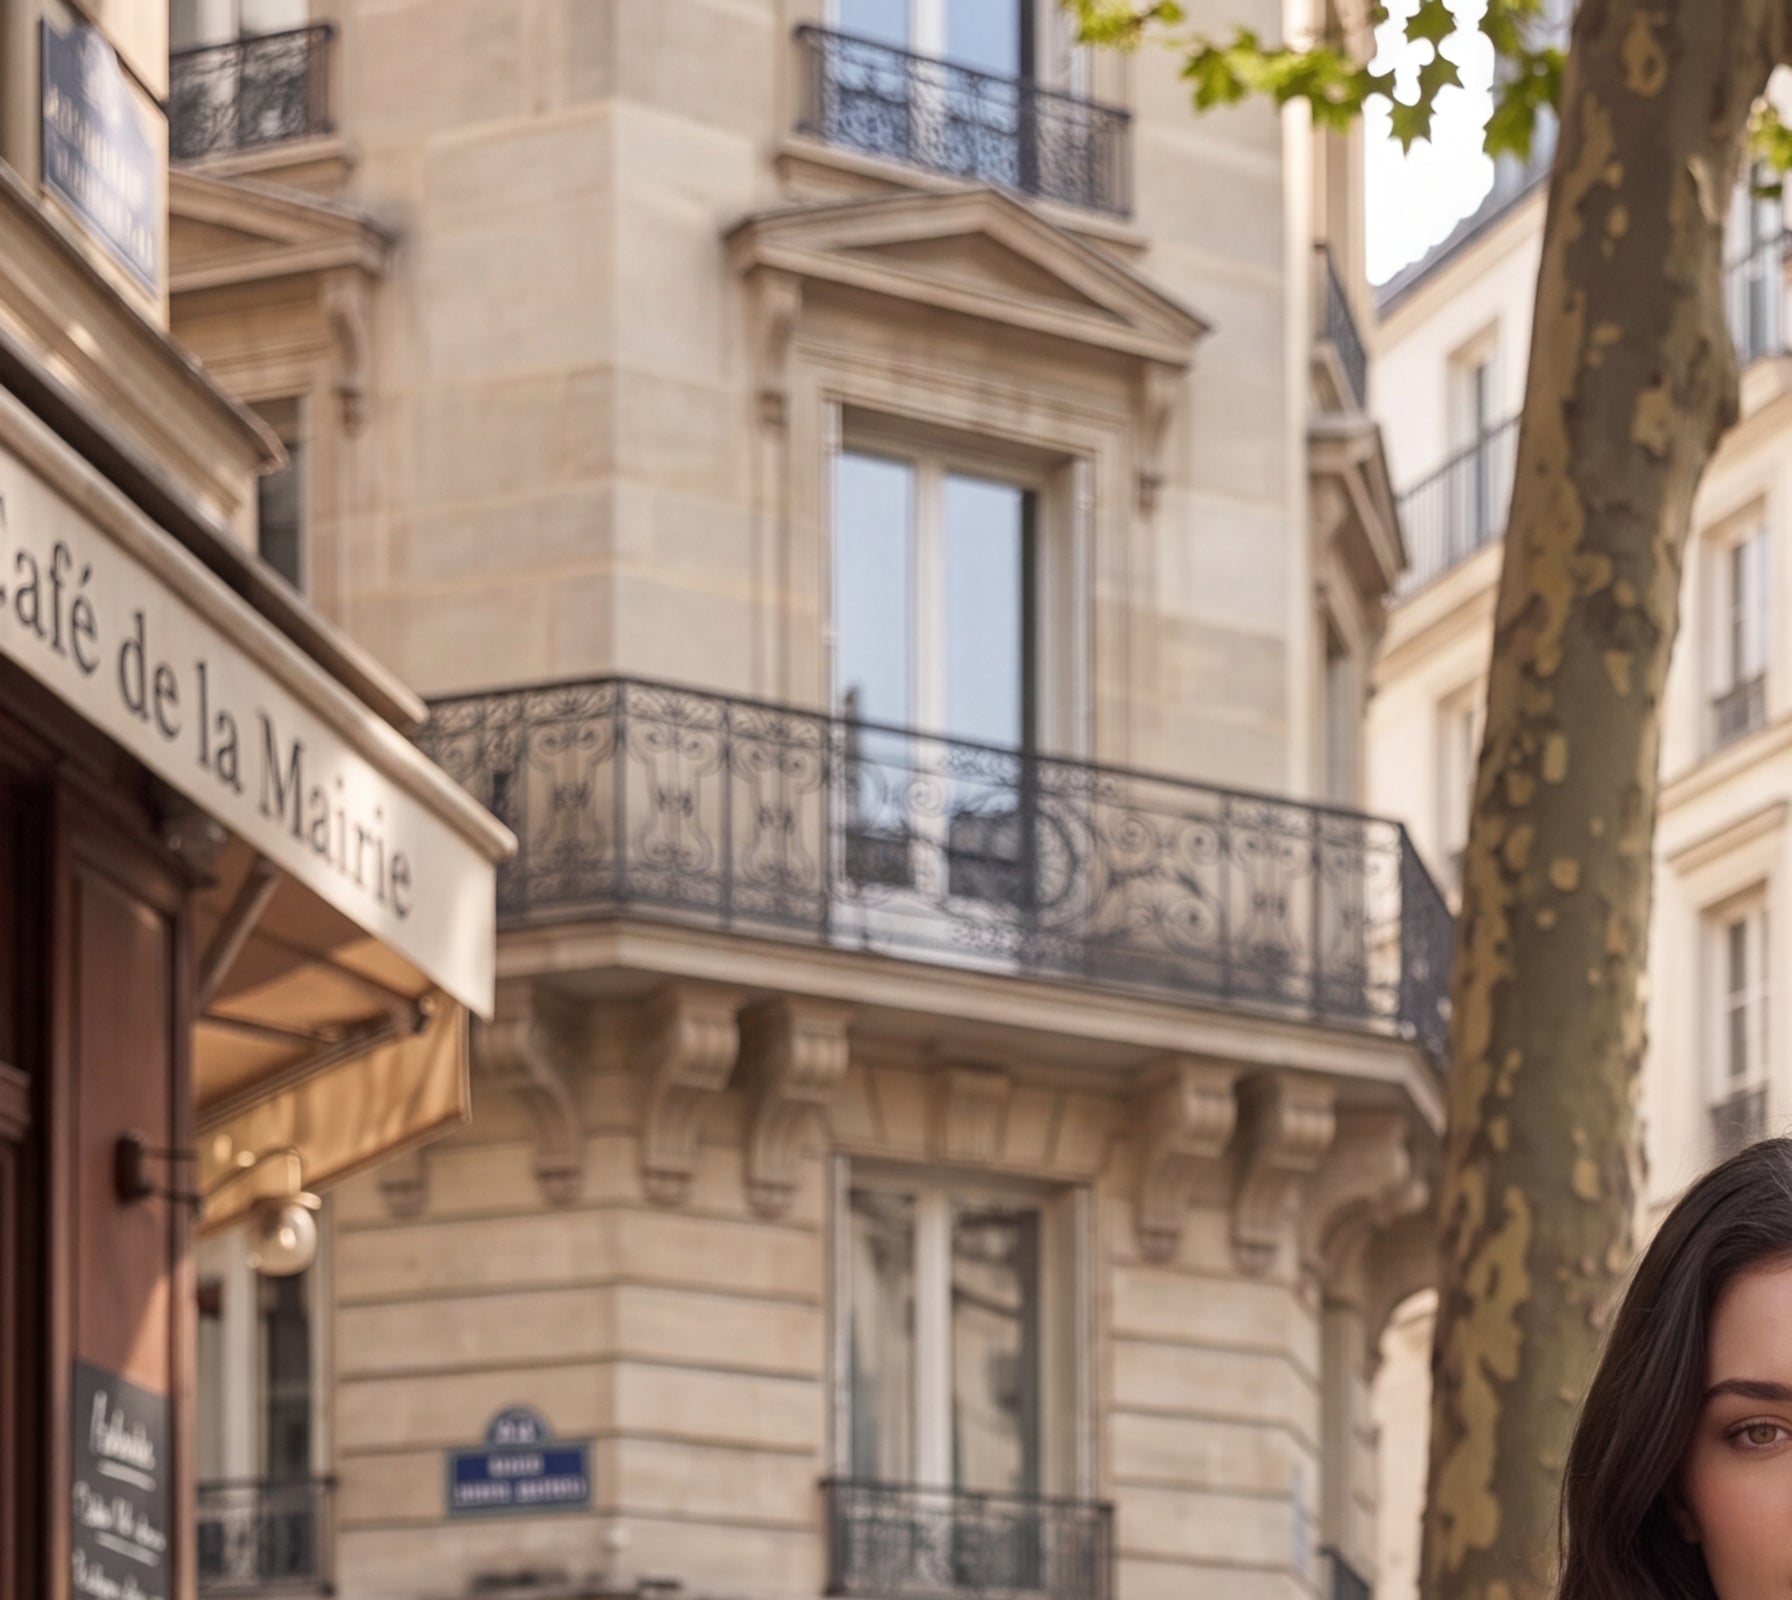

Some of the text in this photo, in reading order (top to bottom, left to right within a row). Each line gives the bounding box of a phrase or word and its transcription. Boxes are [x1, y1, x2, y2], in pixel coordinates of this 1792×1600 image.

[0, 495, 413, 920] afé de la Mairie
